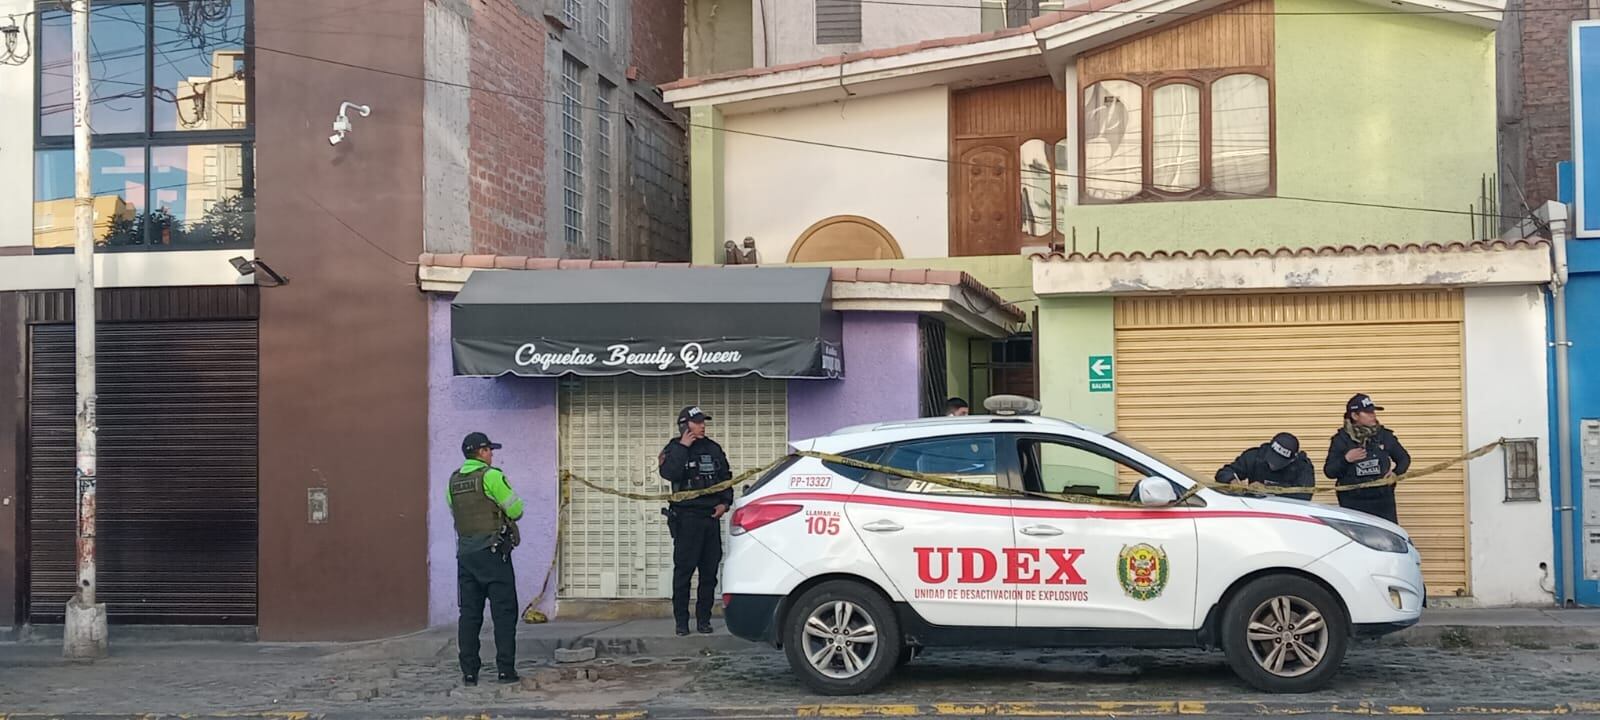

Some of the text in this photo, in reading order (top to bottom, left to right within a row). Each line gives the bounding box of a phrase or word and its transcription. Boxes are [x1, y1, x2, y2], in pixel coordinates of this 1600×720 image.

[514, 342, 742, 370] Coquetas Beauty Queen
[1271, 441, 1291, 458] POLICIA
[790, 476, 831, 487] PP-13327
[805, 516, 841, 535] 105
[913, 547, 1088, 584] UDEX
[914, 588, 945, 599] UNIDAD
[947, 589, 959, 599] DE
[1025, 590, 1036, 600] DE
[1038, 590, 1089, 602] EXPLOSIVOS
